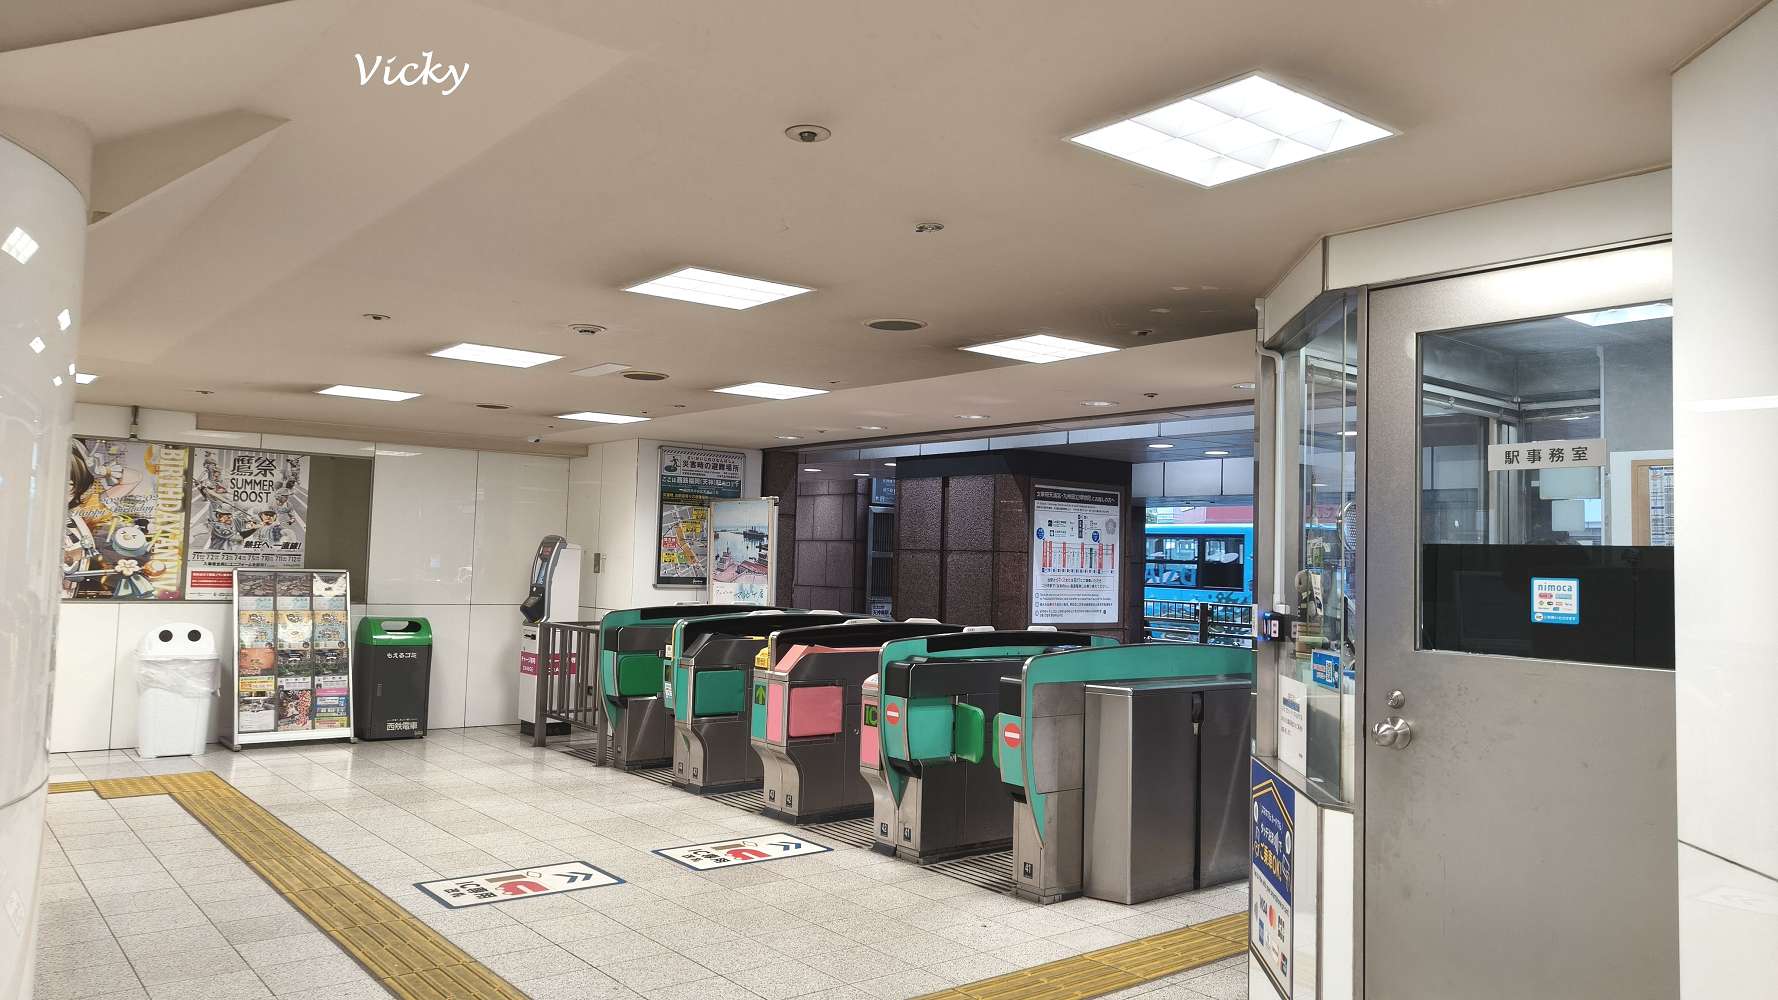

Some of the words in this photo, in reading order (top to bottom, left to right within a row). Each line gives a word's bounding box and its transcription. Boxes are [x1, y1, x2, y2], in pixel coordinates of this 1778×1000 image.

[1504, 446, 1589, 465] 駅事務室
[230, 478, 275, 491] SUMMER
[232, 490, 272, 503] BOOST
[1537, 582, 1573, 592] nimoca
